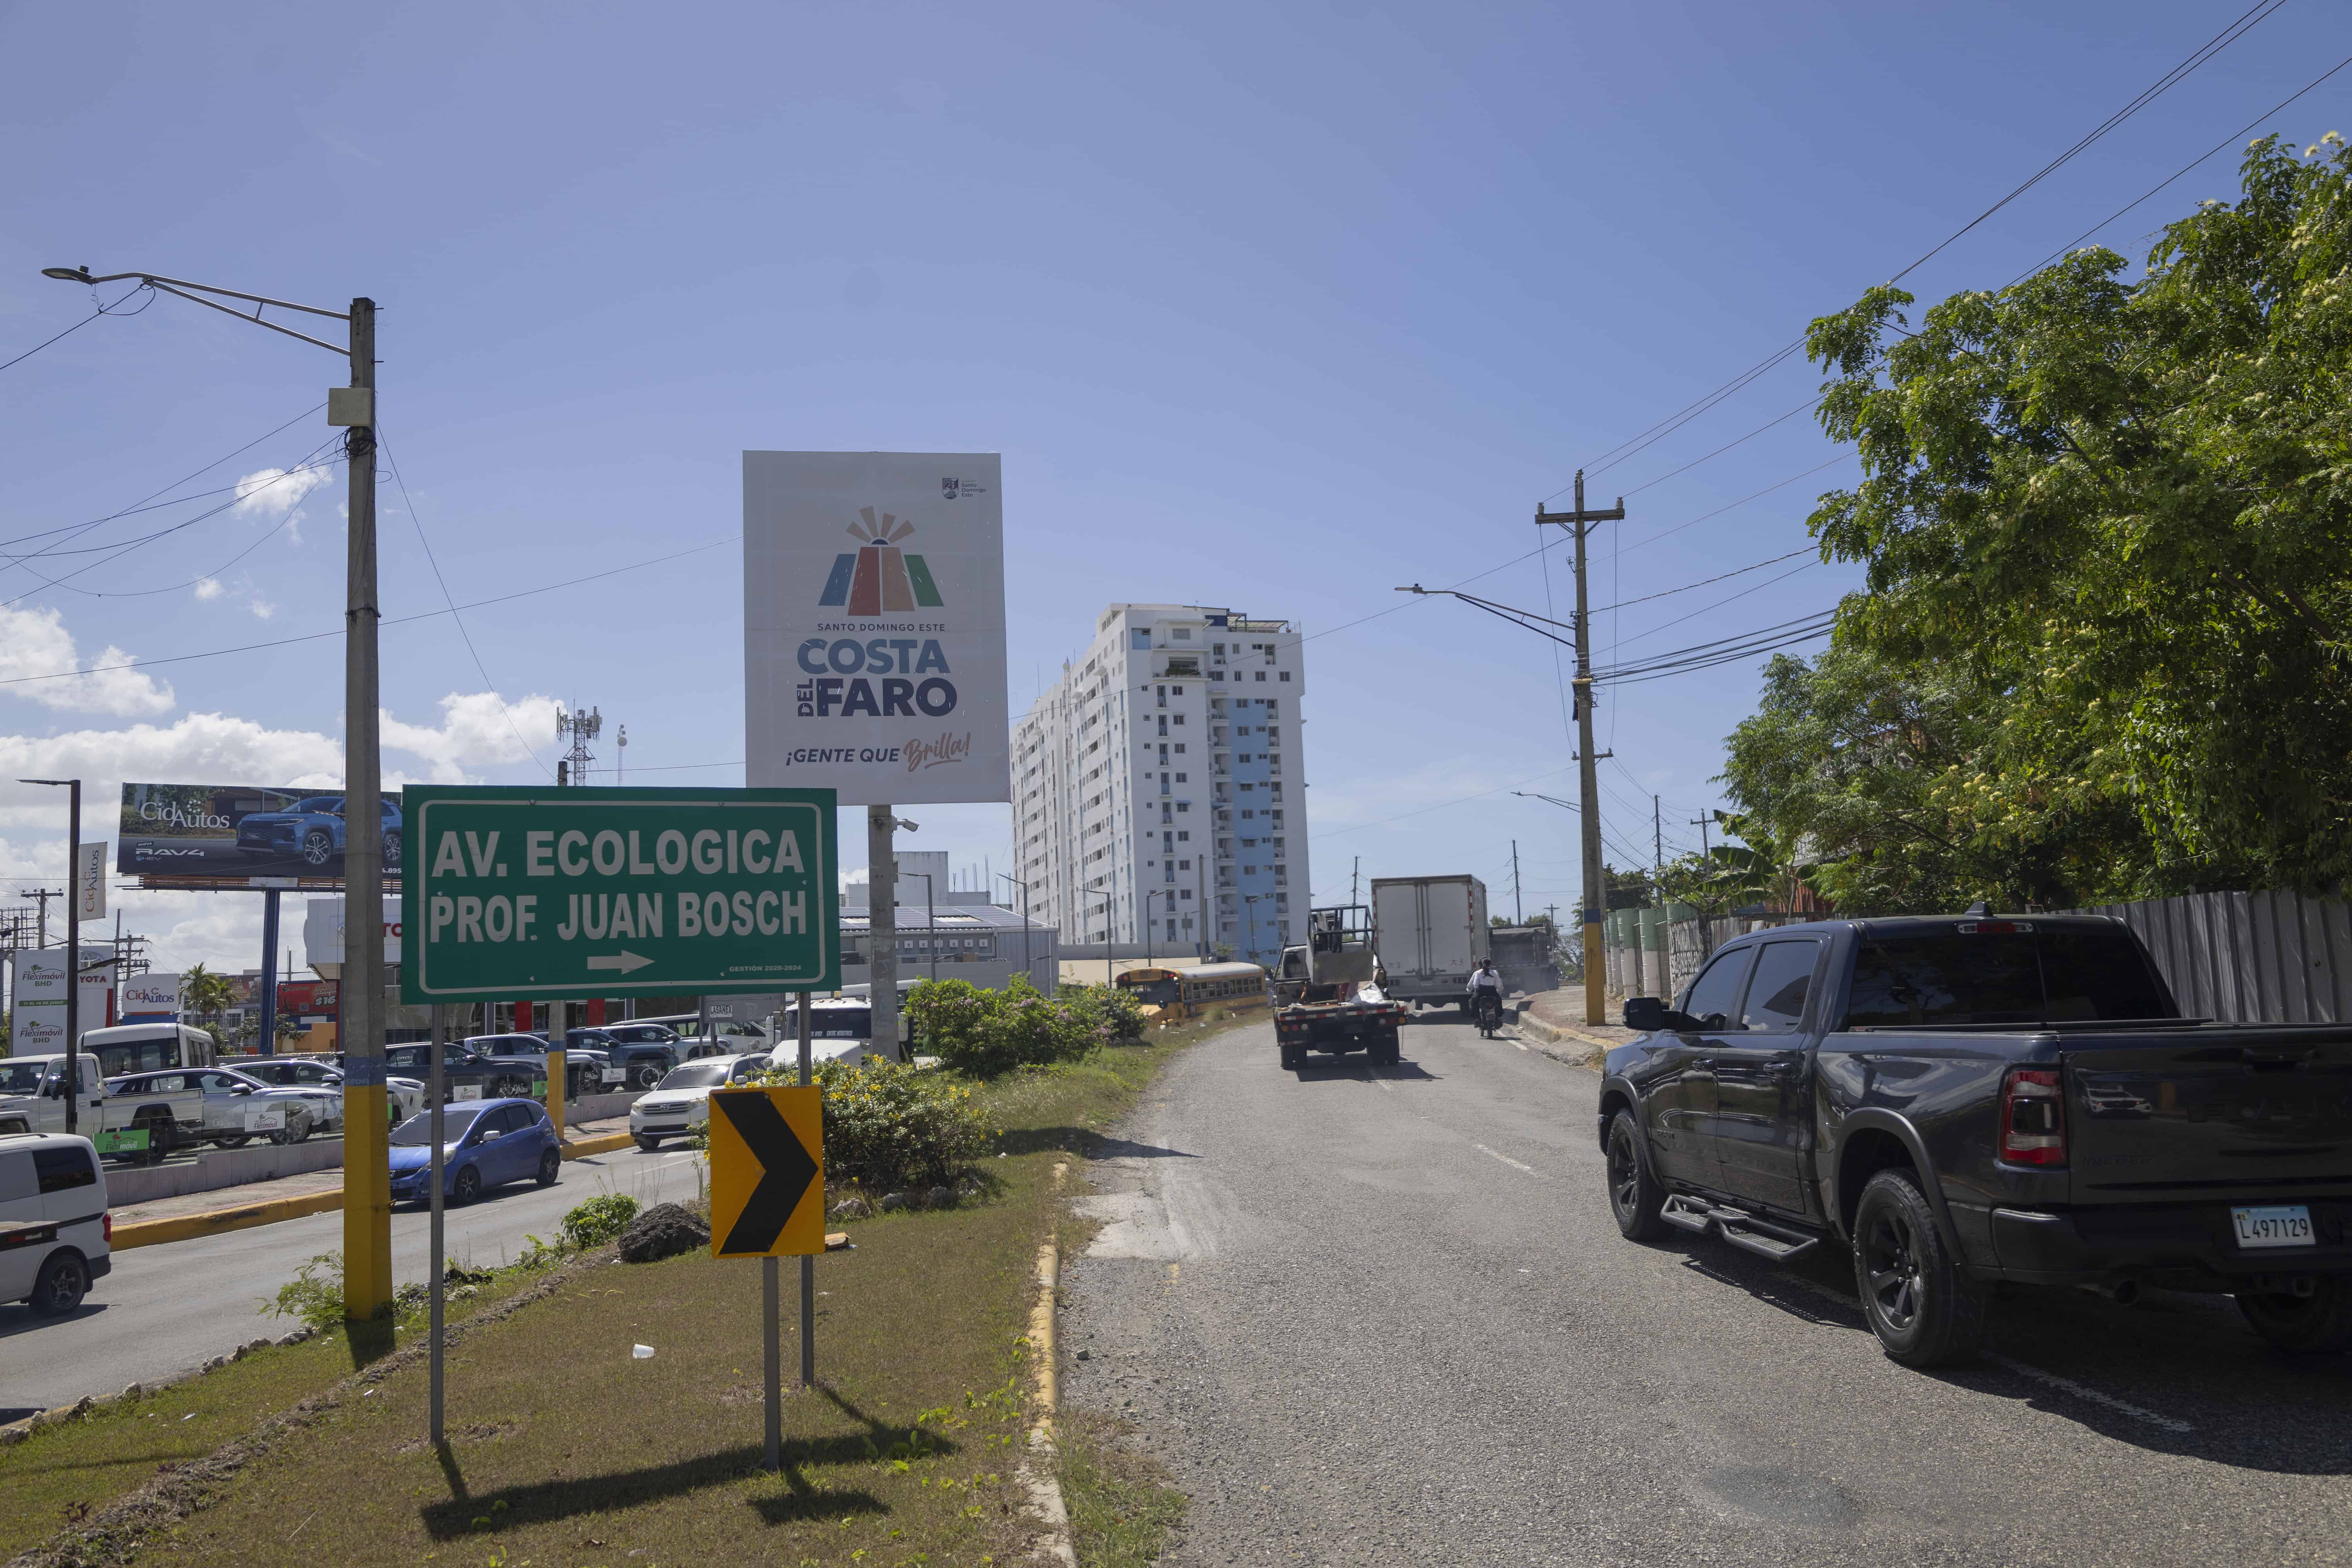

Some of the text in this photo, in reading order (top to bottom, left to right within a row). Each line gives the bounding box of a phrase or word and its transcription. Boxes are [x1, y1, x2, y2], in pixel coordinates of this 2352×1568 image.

[797, 639, 951, 674] COSTA
[797, 679, 814, 717] DEL
[816, 677, 957, 717] FARO
[786, 732, 971, 772] ¡GENTE QUE Brilla!
[140, 801, 230, 828] CidAutos
[432, 829, 805, 877] AV. ECOLOGICA
[85, 850, 99, 912] CidAutos
[431, 891, 806, 942] PROF. JUAN BOSCH
[22, 972, 65, 980] Fleximóvil
[126, 989, 174, 1003] CidAutos
[20, 1029, 63, 1037] Fleximóvil
[254, 1121, 277, 1129] Fleximóvil
[106, 1141, 137, 1151] Fleximóvil
[2239, 1218, 2308, 1238] L497129
